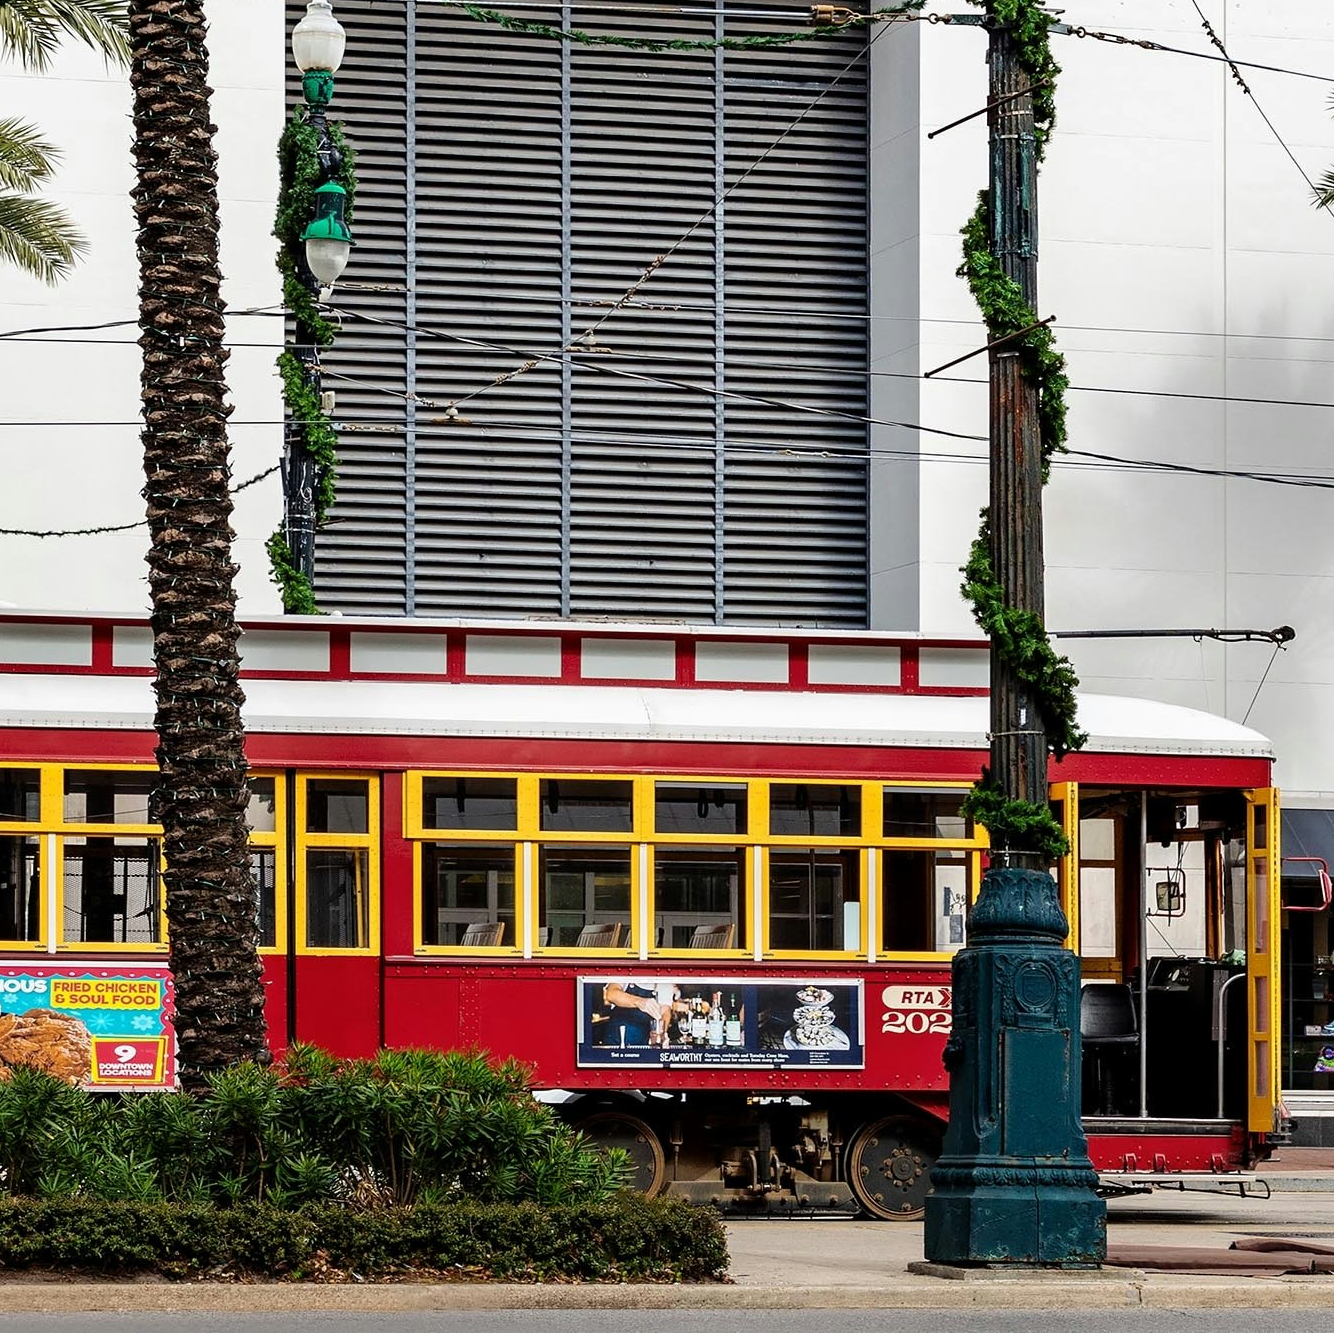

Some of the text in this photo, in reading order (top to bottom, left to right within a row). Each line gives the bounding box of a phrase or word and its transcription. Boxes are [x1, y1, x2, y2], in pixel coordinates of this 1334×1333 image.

[53, 982, 157, 993] FRIED CHICKEN
[55, 994, 156, 1005] & SOUL FOOD
[901, 991, 934, 1004] RTA
[882, 1011, 953, 1034] 202
[114, 1045, 137, 1063] 9
[659, 1052, 703, 1062] SEAWORTHY
